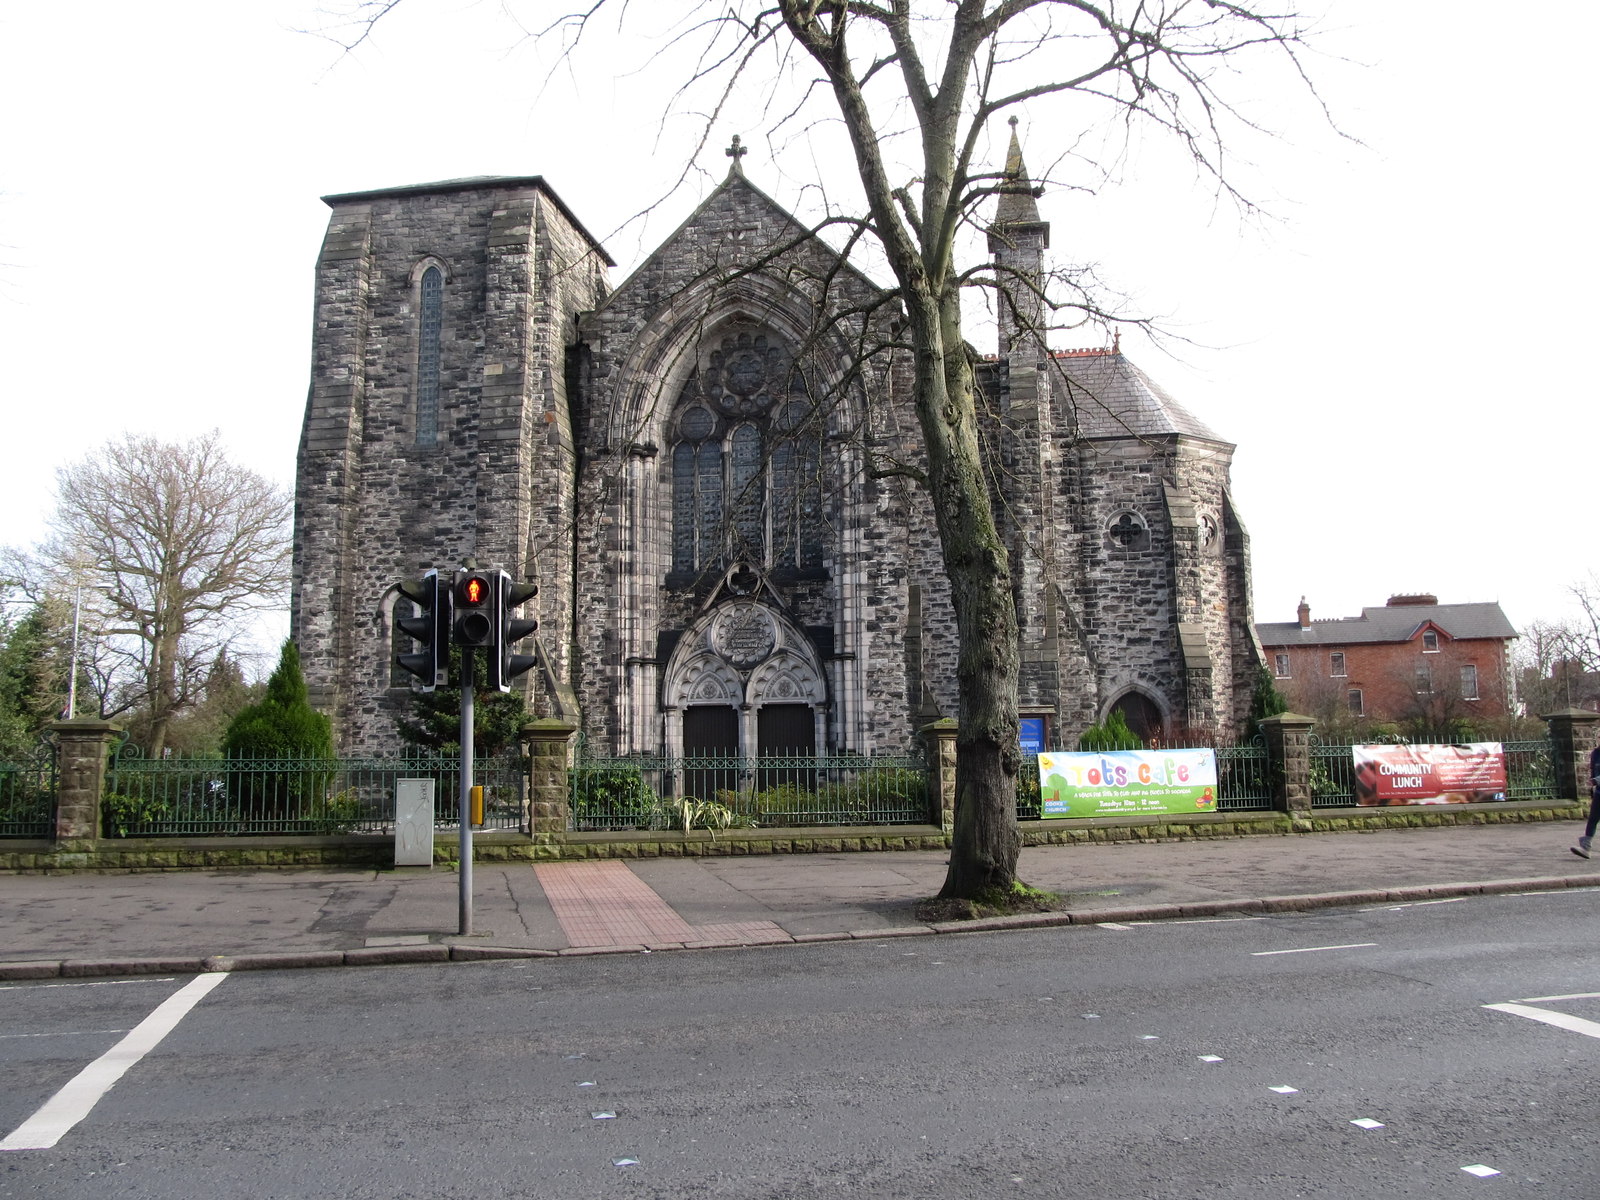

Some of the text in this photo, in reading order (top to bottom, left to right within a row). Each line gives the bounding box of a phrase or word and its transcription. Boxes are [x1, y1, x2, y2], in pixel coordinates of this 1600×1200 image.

[1069, 758, 1127, 786] Tots
[1379, 764, 1432, 775] COMMUNITY
[1392, 776, 1423, 788] LUNCH
